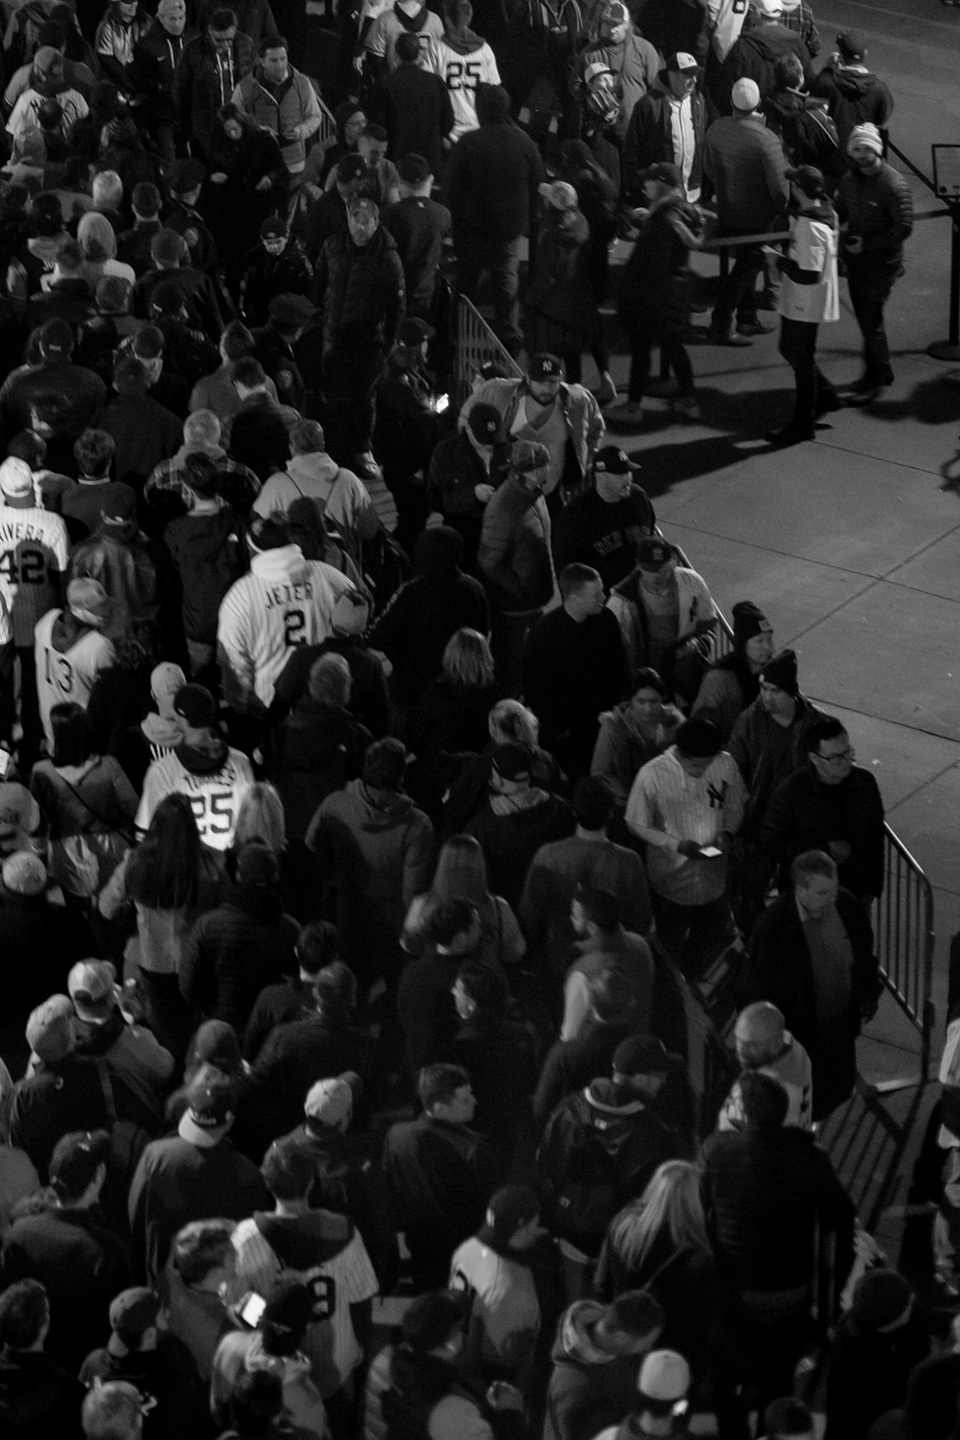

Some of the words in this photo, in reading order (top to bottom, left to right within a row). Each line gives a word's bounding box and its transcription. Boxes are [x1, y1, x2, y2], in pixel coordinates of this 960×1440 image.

[446, 62, 481, 90] 25
[265, 581, 313, 610] JETER
[284, 608, 307, 647] 2
[707, 779, 730, 810] NY
[189, 792, 234, 834] 25
